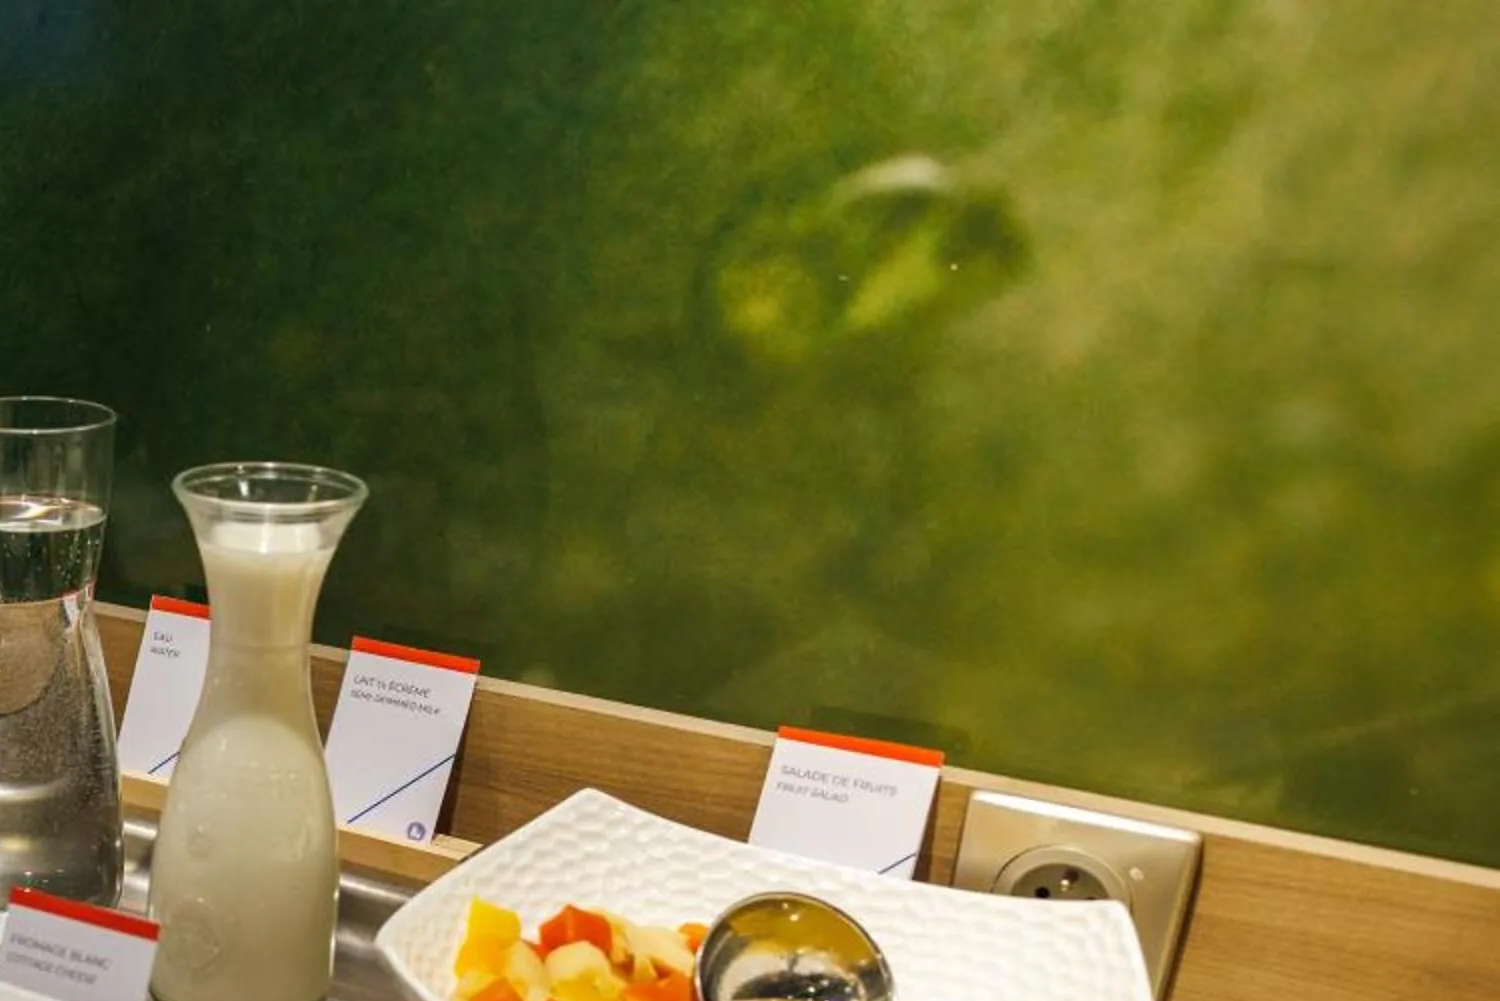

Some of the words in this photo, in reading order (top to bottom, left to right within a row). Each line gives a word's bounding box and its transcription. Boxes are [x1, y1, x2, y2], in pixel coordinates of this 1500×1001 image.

[777, 781, 809, 796] FRUIT
[810, 789, 849, 803] SALAD
[781, 765, 829, 784] SALADE
[831, 775, 850, 788] DE
[852, 778, 898, 798] FRUITS
[9, 933, 67, 959] FROMAGE
[70, 949, 114, 971] BLANC
